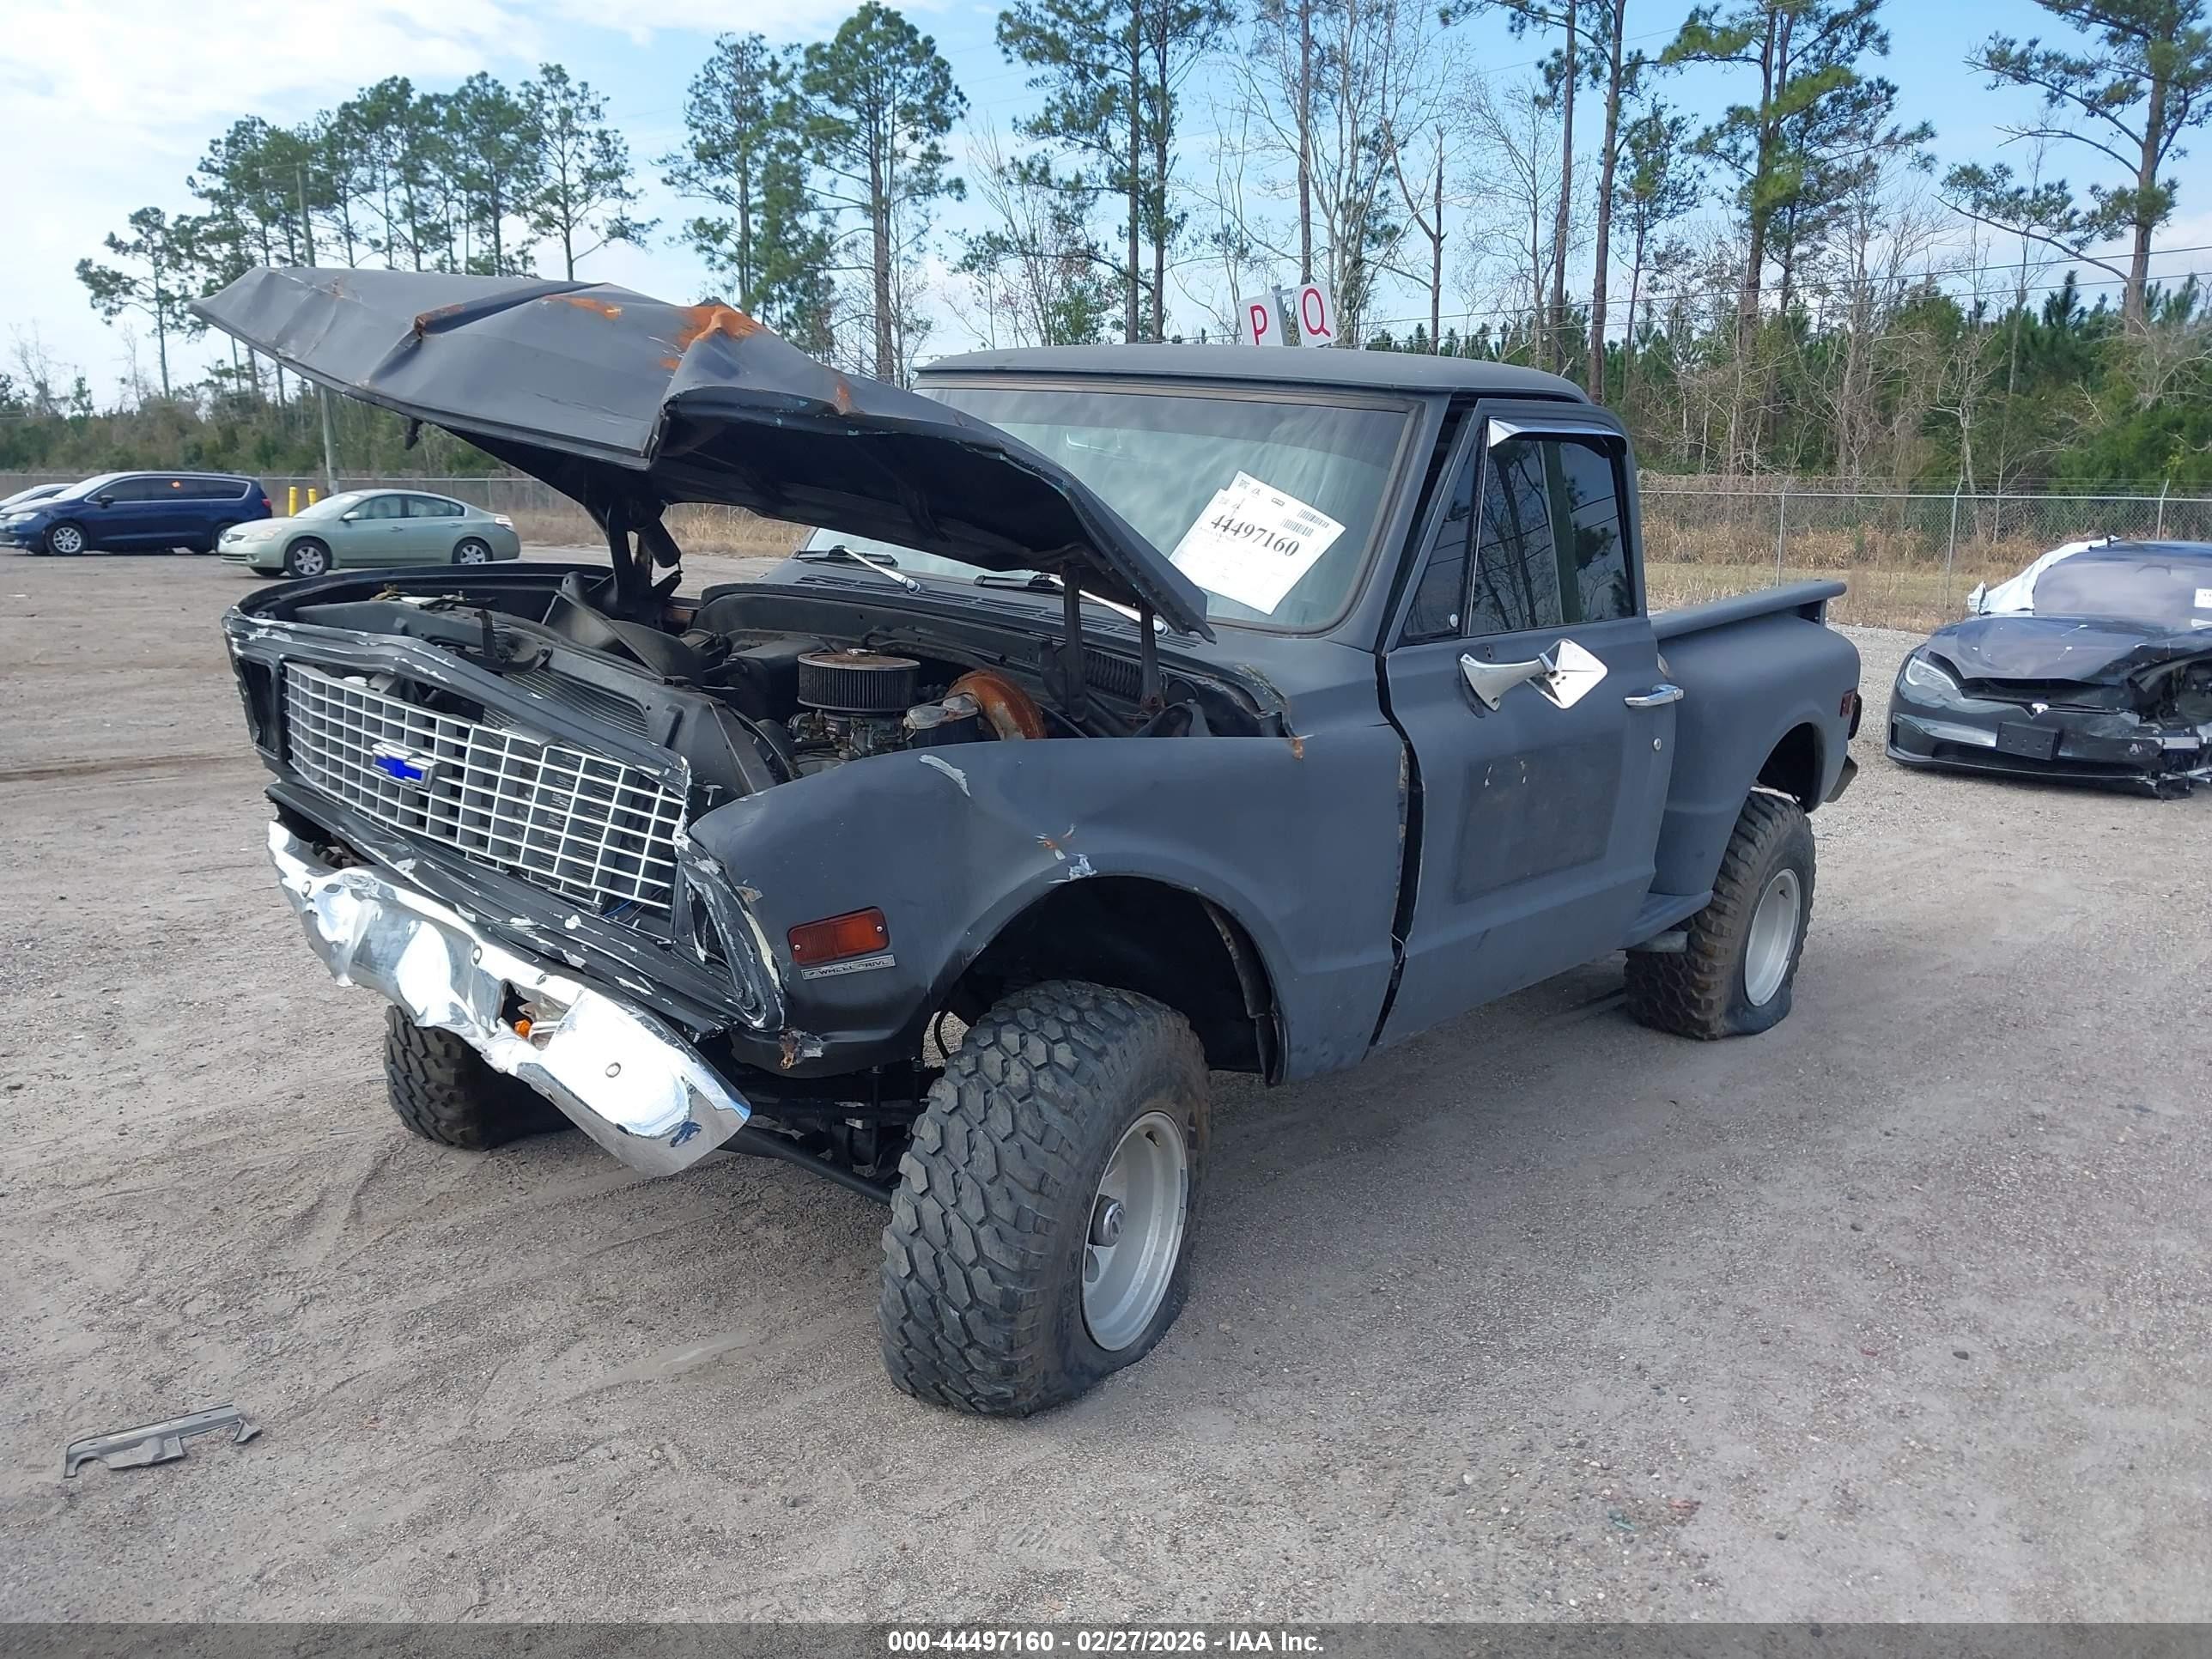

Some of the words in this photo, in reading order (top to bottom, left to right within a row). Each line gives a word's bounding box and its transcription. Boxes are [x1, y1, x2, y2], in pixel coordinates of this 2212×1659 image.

[1249, 304, 1268, 345] P
[1302, 288, 1331, 337] Q
[1211, 514, 1300, 557] 44497160
